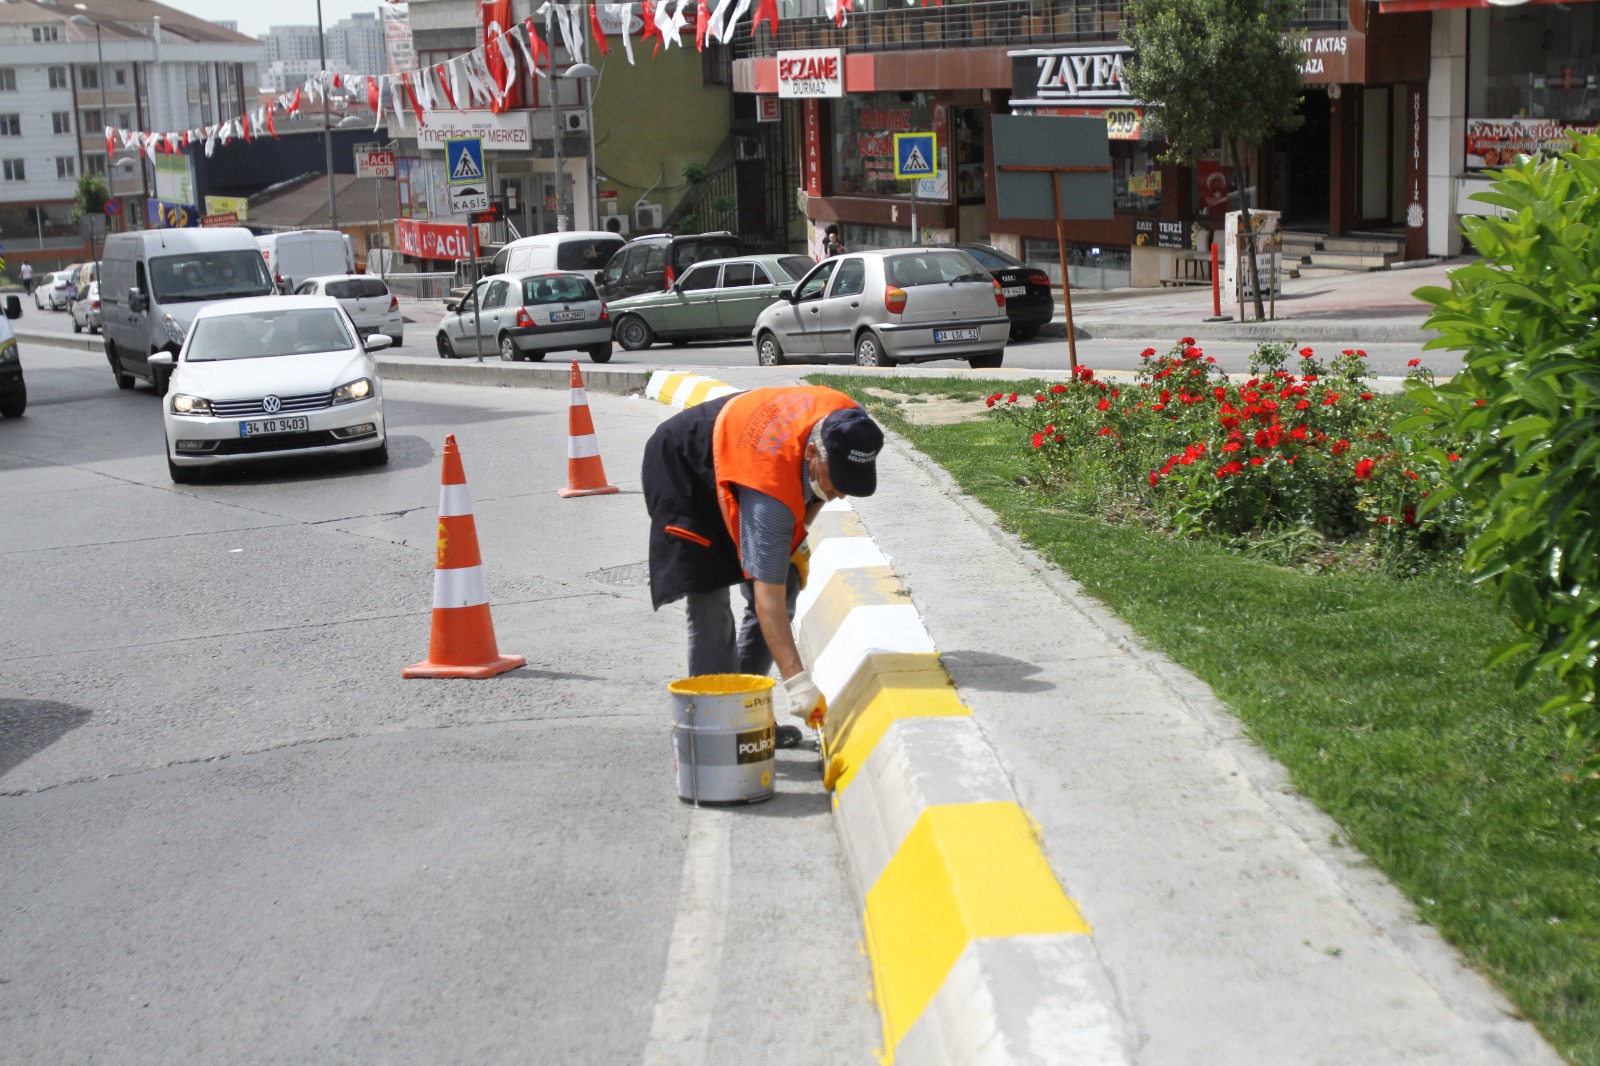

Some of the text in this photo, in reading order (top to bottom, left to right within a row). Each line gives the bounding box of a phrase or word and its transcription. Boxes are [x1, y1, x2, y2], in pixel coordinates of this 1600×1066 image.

[1315, 36, 1347, 55] AKTAŞ
[779, 56, 838, 81] ECZANE
[793, 82, 826, 94] DURMAZ
[861, 109, 911, 129] DURMAZ
[1108, 111, 1136, 133] 299
[488, 126, 528, 143] MERKEZİ
[1474, 126, 1524, 138] YAMAN
[808, 98, 817, 188] ECZANE
[858, 135, 894, 156] ECZAN
[370, 152, 394, 166] ACİL
[375, 166, 389, 177] DİŞ
[920, 181, 936, 193] SGK
[453, 198, 487, 211] KASİS
[1159, 221, 1183, 233] TERZİ
[436, 229, 471, 257] ACİL
[938, 331, 948, 340] 34
[968, 328, 977, 337] 52
[247, 418, 305, 434] 34 KD 9403
